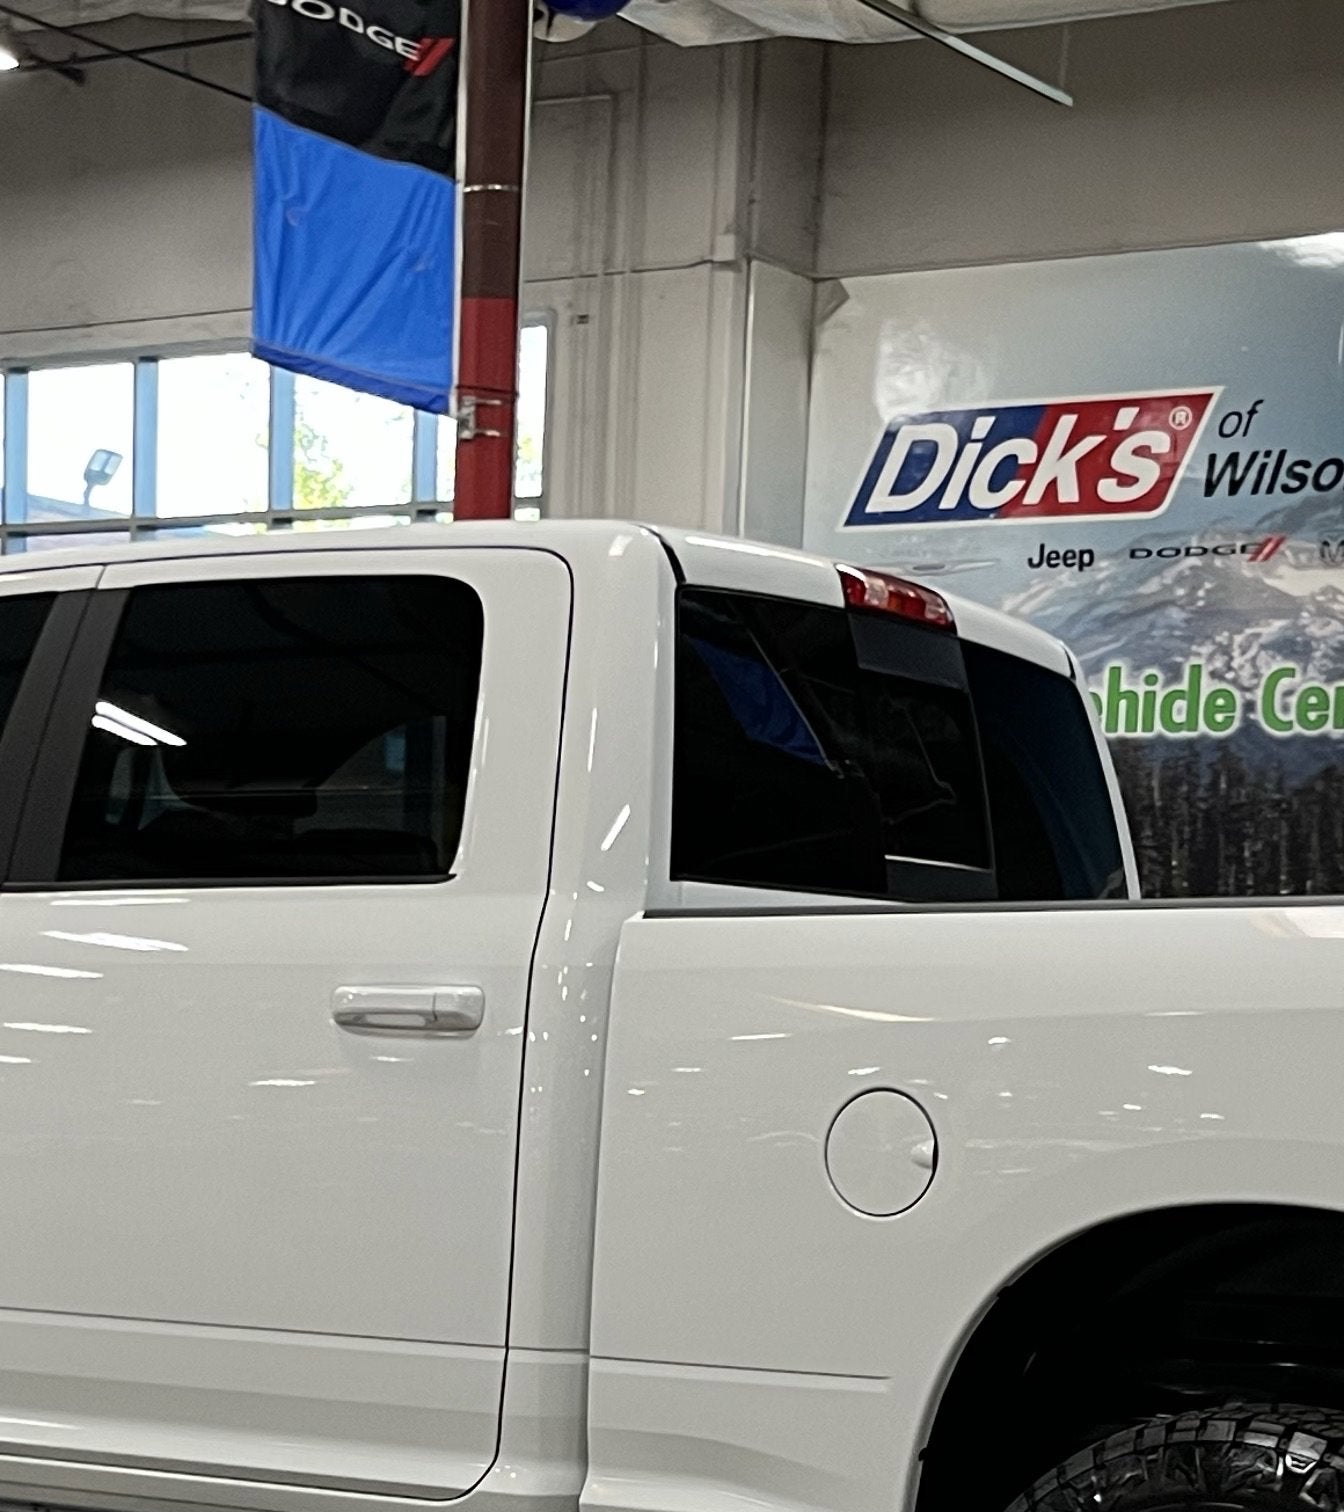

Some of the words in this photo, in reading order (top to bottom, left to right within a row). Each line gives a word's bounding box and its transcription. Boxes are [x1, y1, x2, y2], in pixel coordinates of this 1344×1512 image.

[266, 0, 423, 61] ODGE
[865, 408, 1171, 514] Dick's
[1218, 399, 1263, 439] of
[1027, 543, 1095, 570] Jeep
